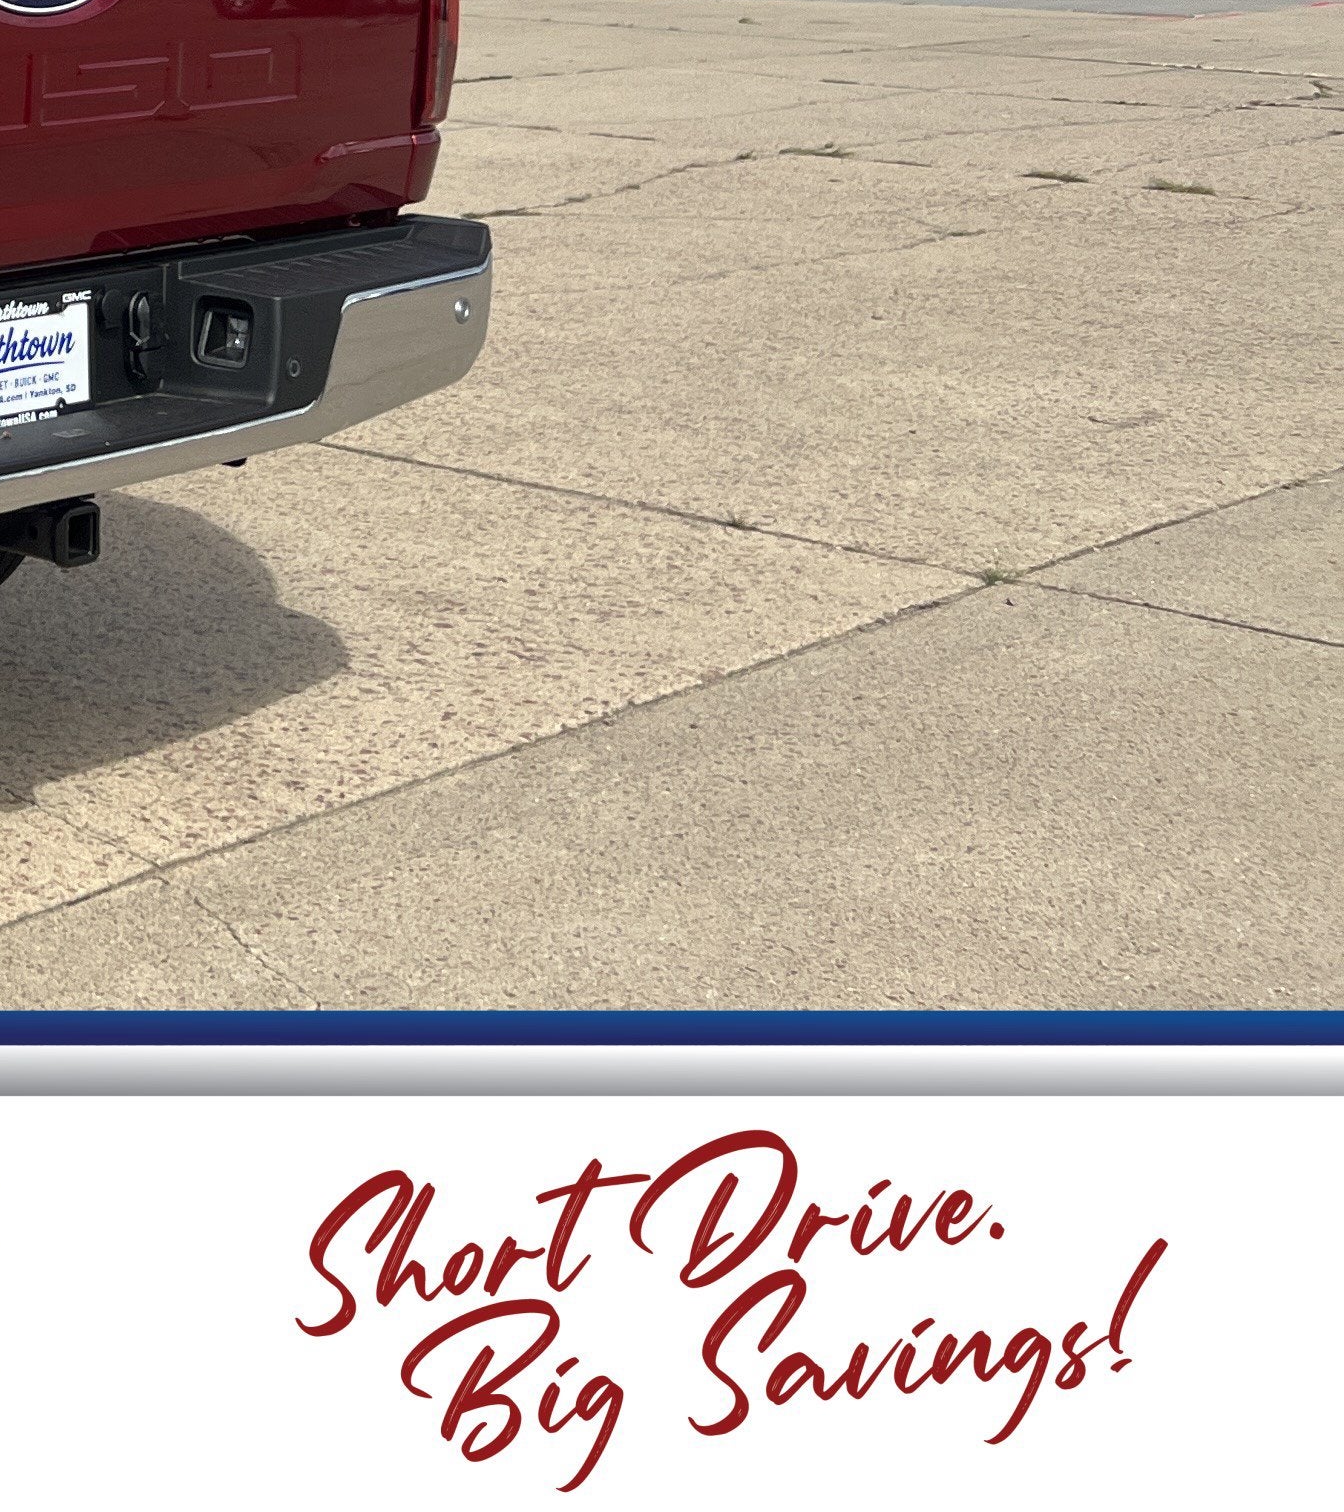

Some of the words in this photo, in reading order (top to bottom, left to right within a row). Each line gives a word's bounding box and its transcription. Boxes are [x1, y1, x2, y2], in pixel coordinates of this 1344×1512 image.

[62, 290, 92, 303] GMC
[14, 375, 37, 388] BUICK
[43, 371, 60, 383] GMC
[29, 387, 63, 399] Yankton,
[65, 383, 77, 393] SD
